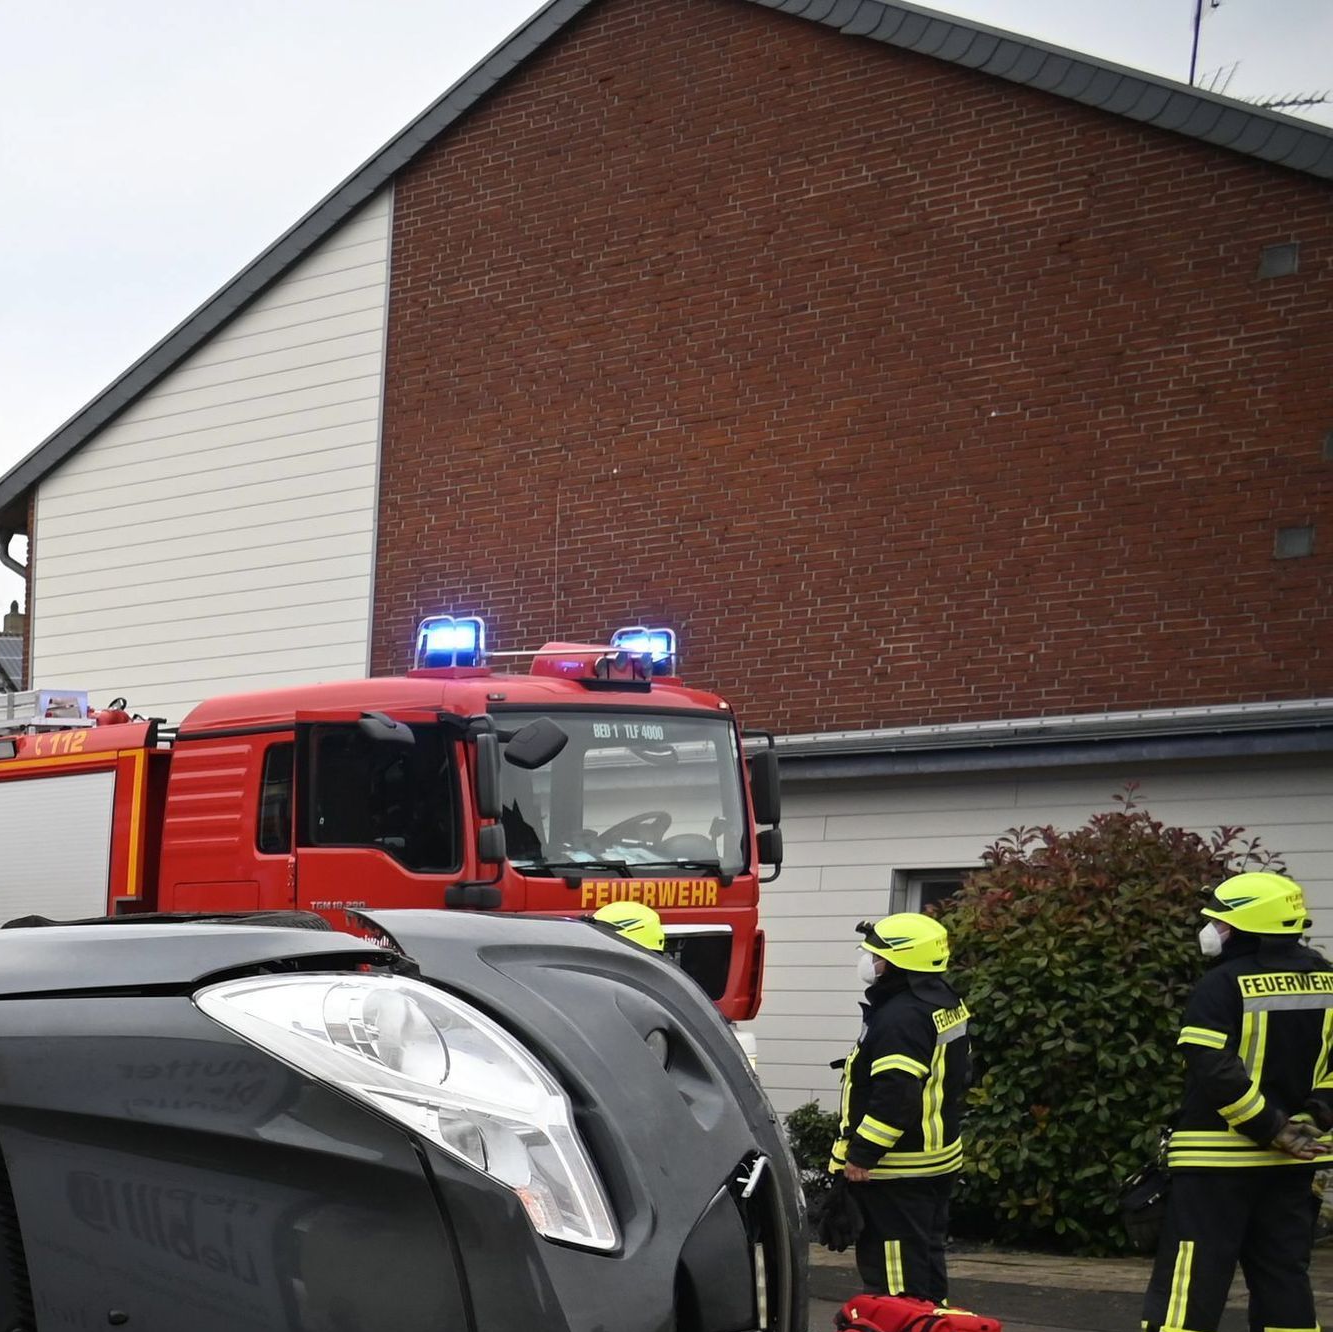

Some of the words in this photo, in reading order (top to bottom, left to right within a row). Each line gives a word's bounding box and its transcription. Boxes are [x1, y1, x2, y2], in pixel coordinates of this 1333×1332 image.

[50, 731, 87, 754] 112
[593, 723, 611, 738] BED
[613, 724, 619, 738] 1
[624, 724, 639, 739] TLF
[641, 725, 664, 740] 4000
[581, 880, 718, 908] FEUERWEHR
